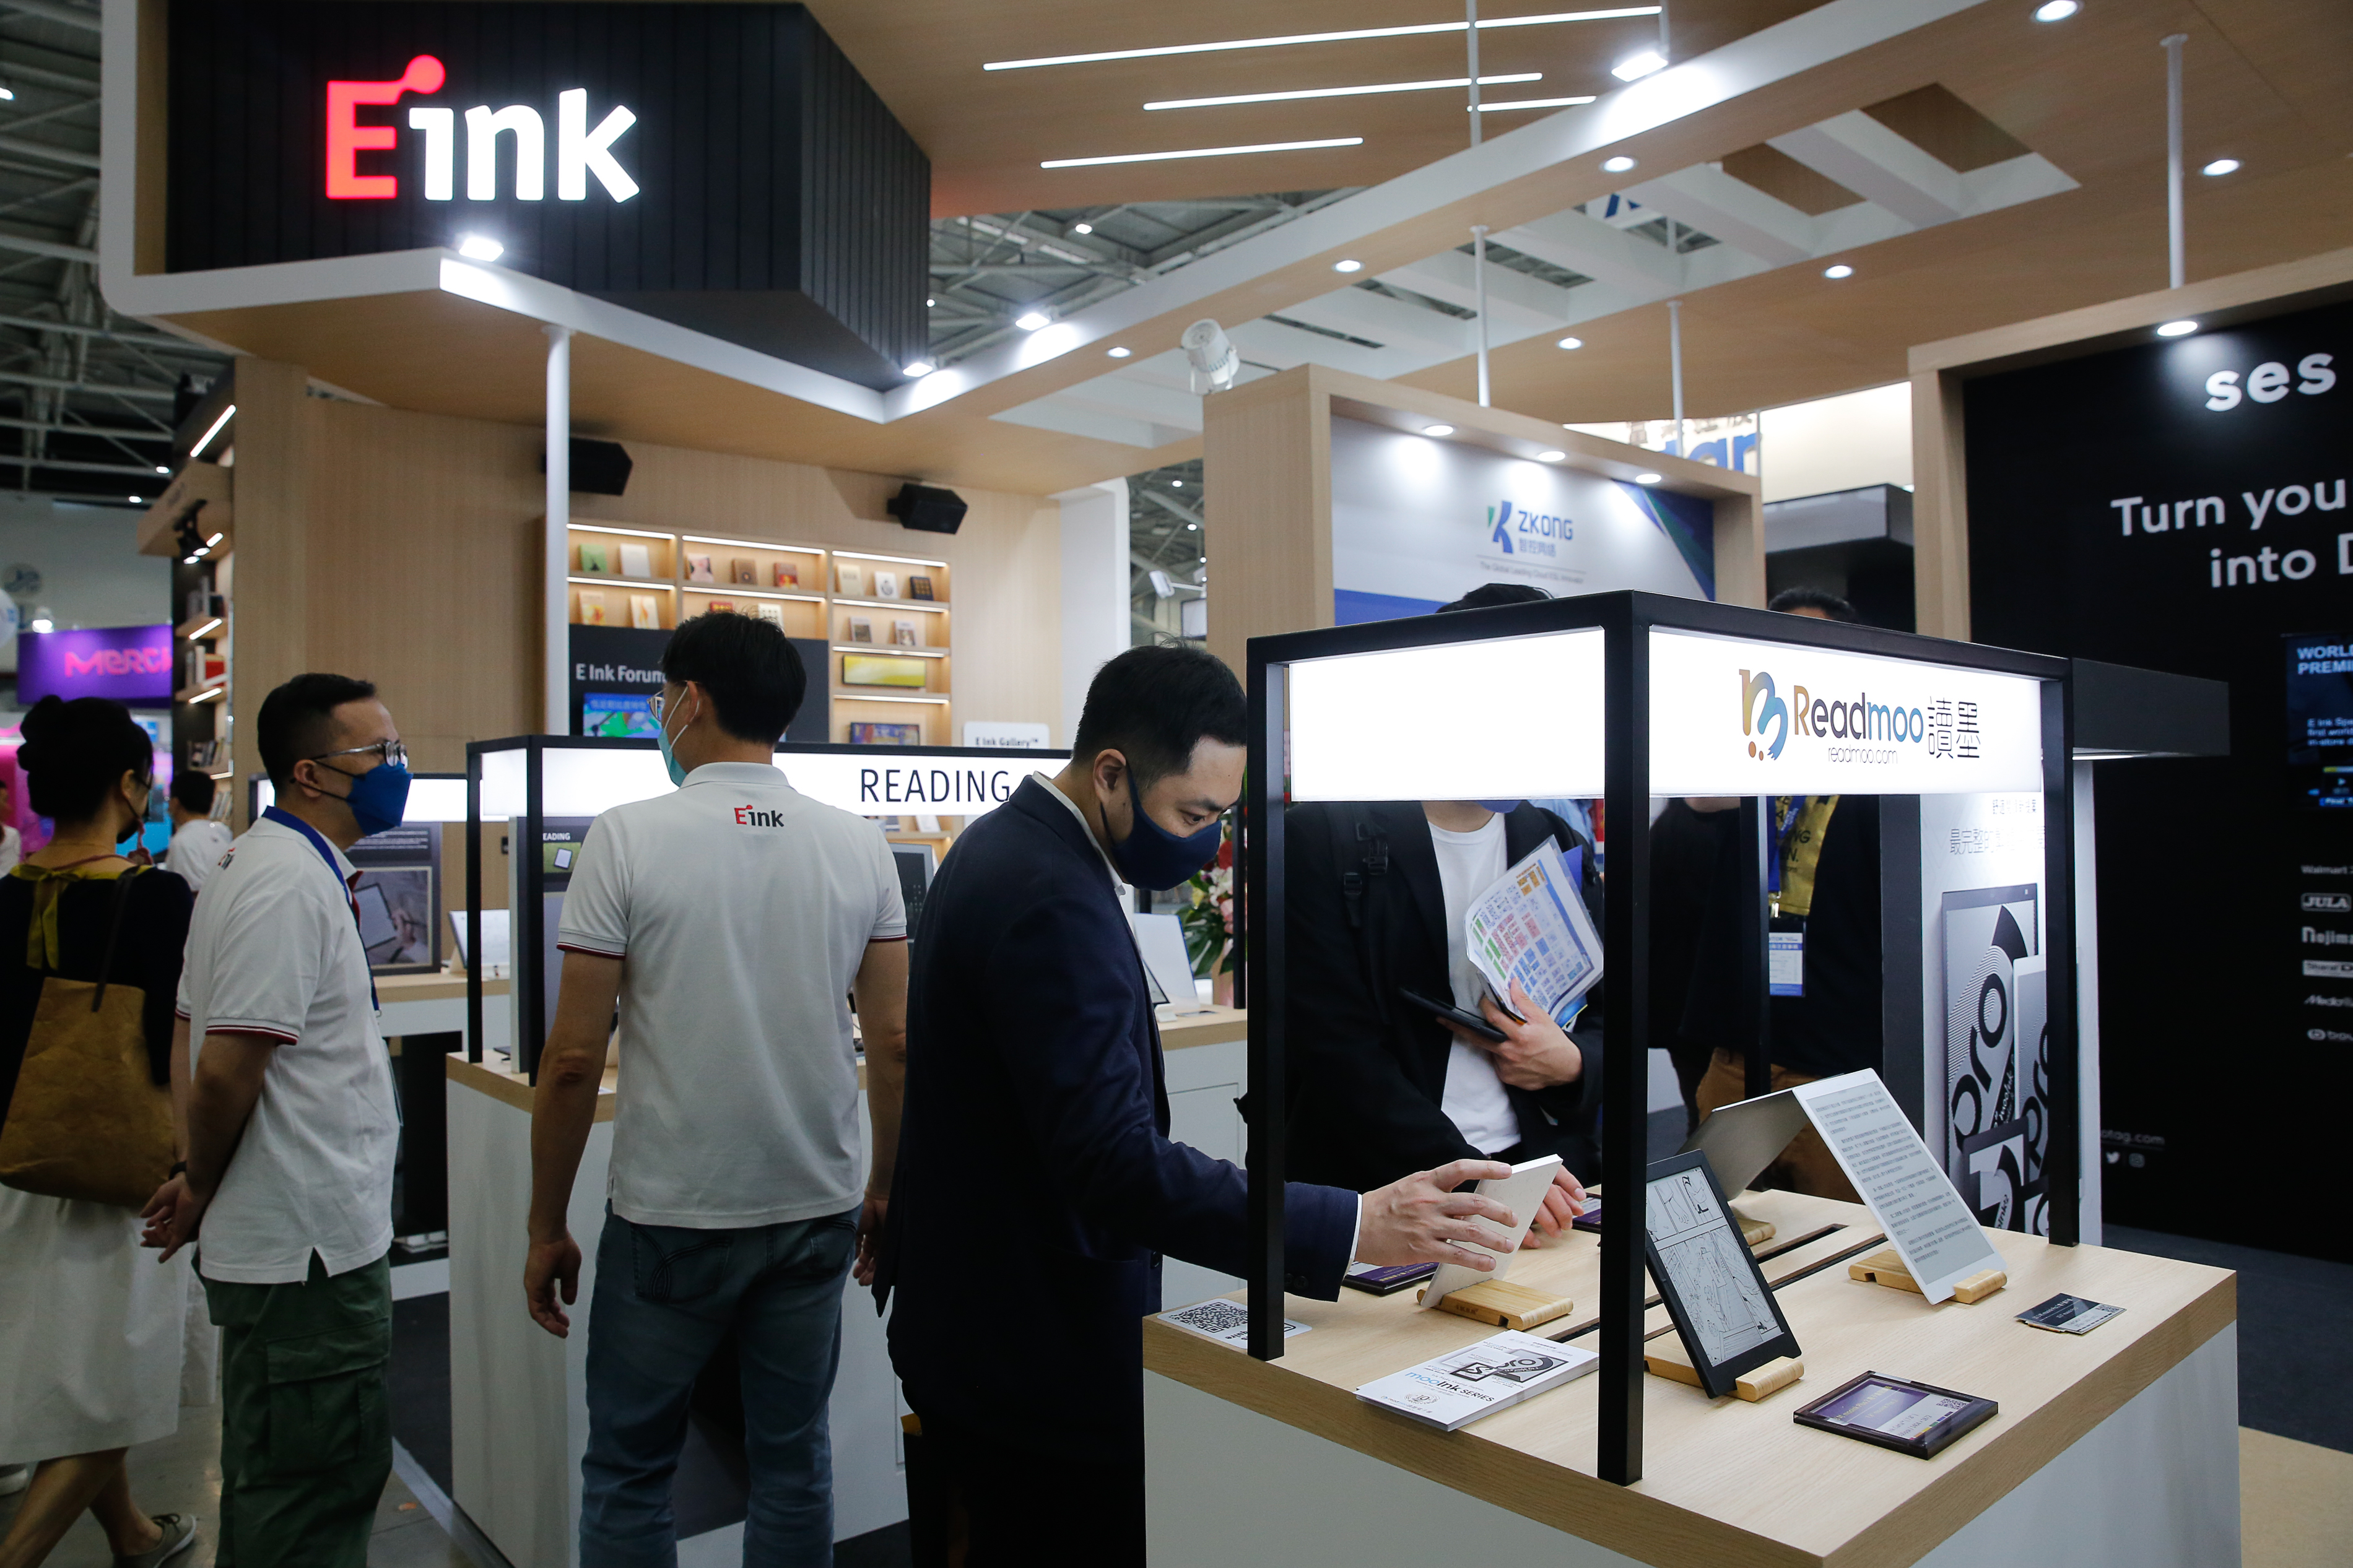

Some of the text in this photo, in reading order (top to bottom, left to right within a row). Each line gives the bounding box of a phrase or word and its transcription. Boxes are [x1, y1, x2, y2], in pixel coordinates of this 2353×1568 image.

[2204, 353, 2337, 412] ses
[2110, 479, 2346, 536] Turn you
[1519, 510, 1573, 540] ZKONG
[2209, 546, 2316, 588] into
[576, 663, 668, 683] E Ink Forum
[1793, 685, 1981, 759] Readmoo 讀墨
[1828, 745, 1898, 764] readmoo.com
[861, 769, 1010, 802] READING
[542, 832, 571, 841] EADING
[2302, 896, 2348, 908] JULA
[1460, 1388, 1495, 1402] SERIES
